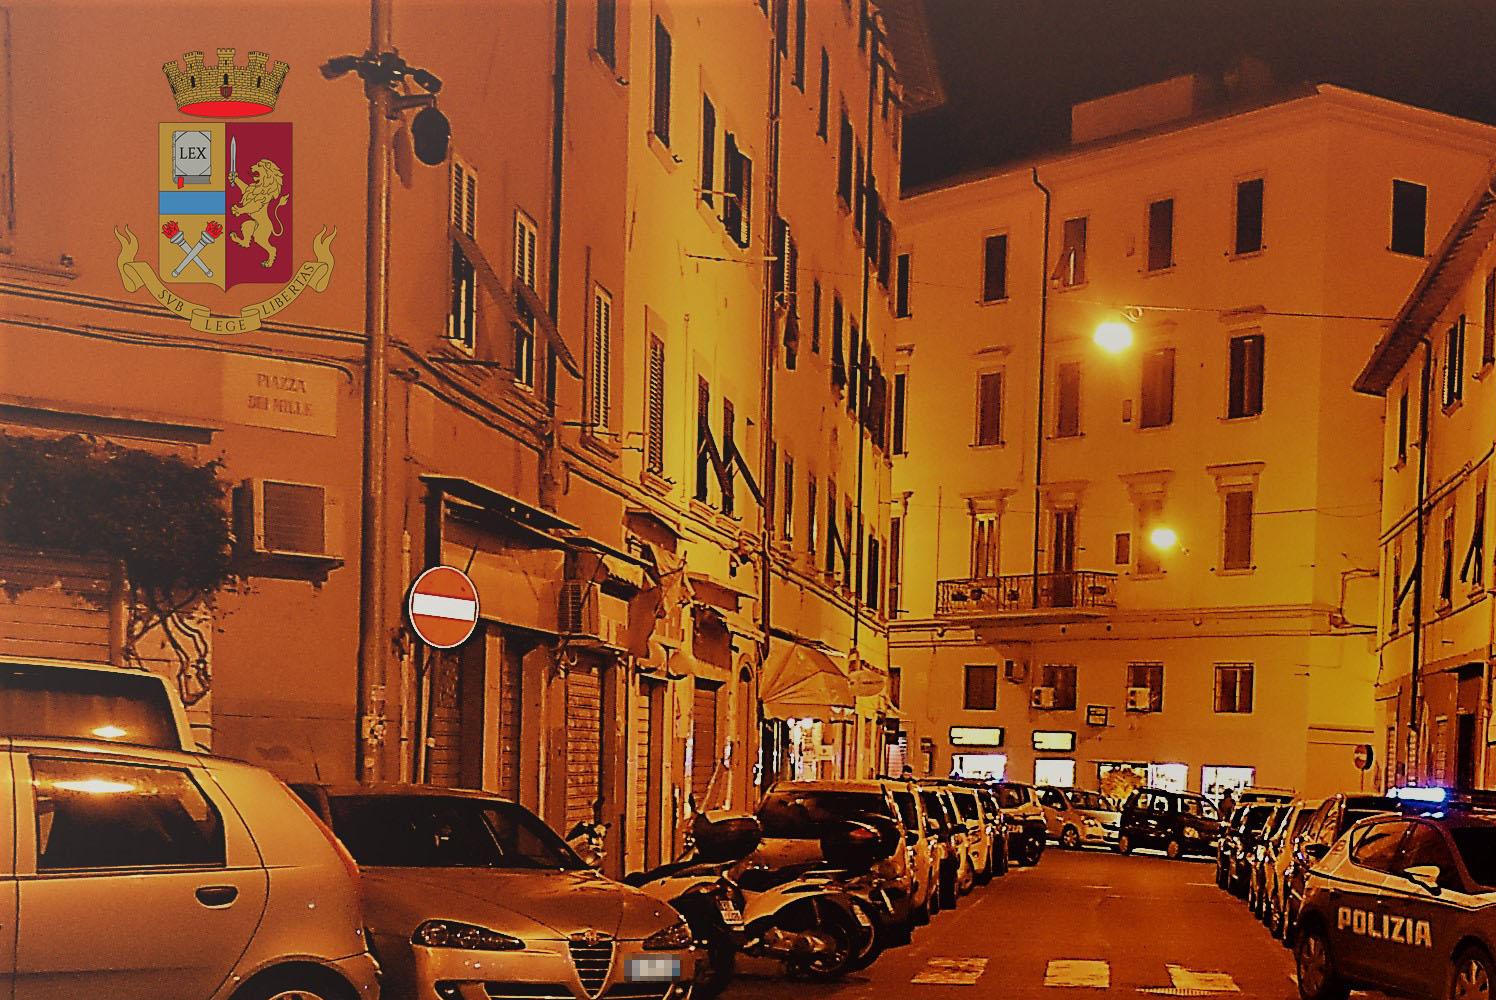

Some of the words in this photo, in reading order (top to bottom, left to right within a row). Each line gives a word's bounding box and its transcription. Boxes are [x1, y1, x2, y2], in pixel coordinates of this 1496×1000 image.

[256, 373, 306, 393] PIAZZA
[247, 395, 268, 411] DEI
[272, 398, 313, 416] MILLE
[1337, 905, 1432, 948] POLIZIA
